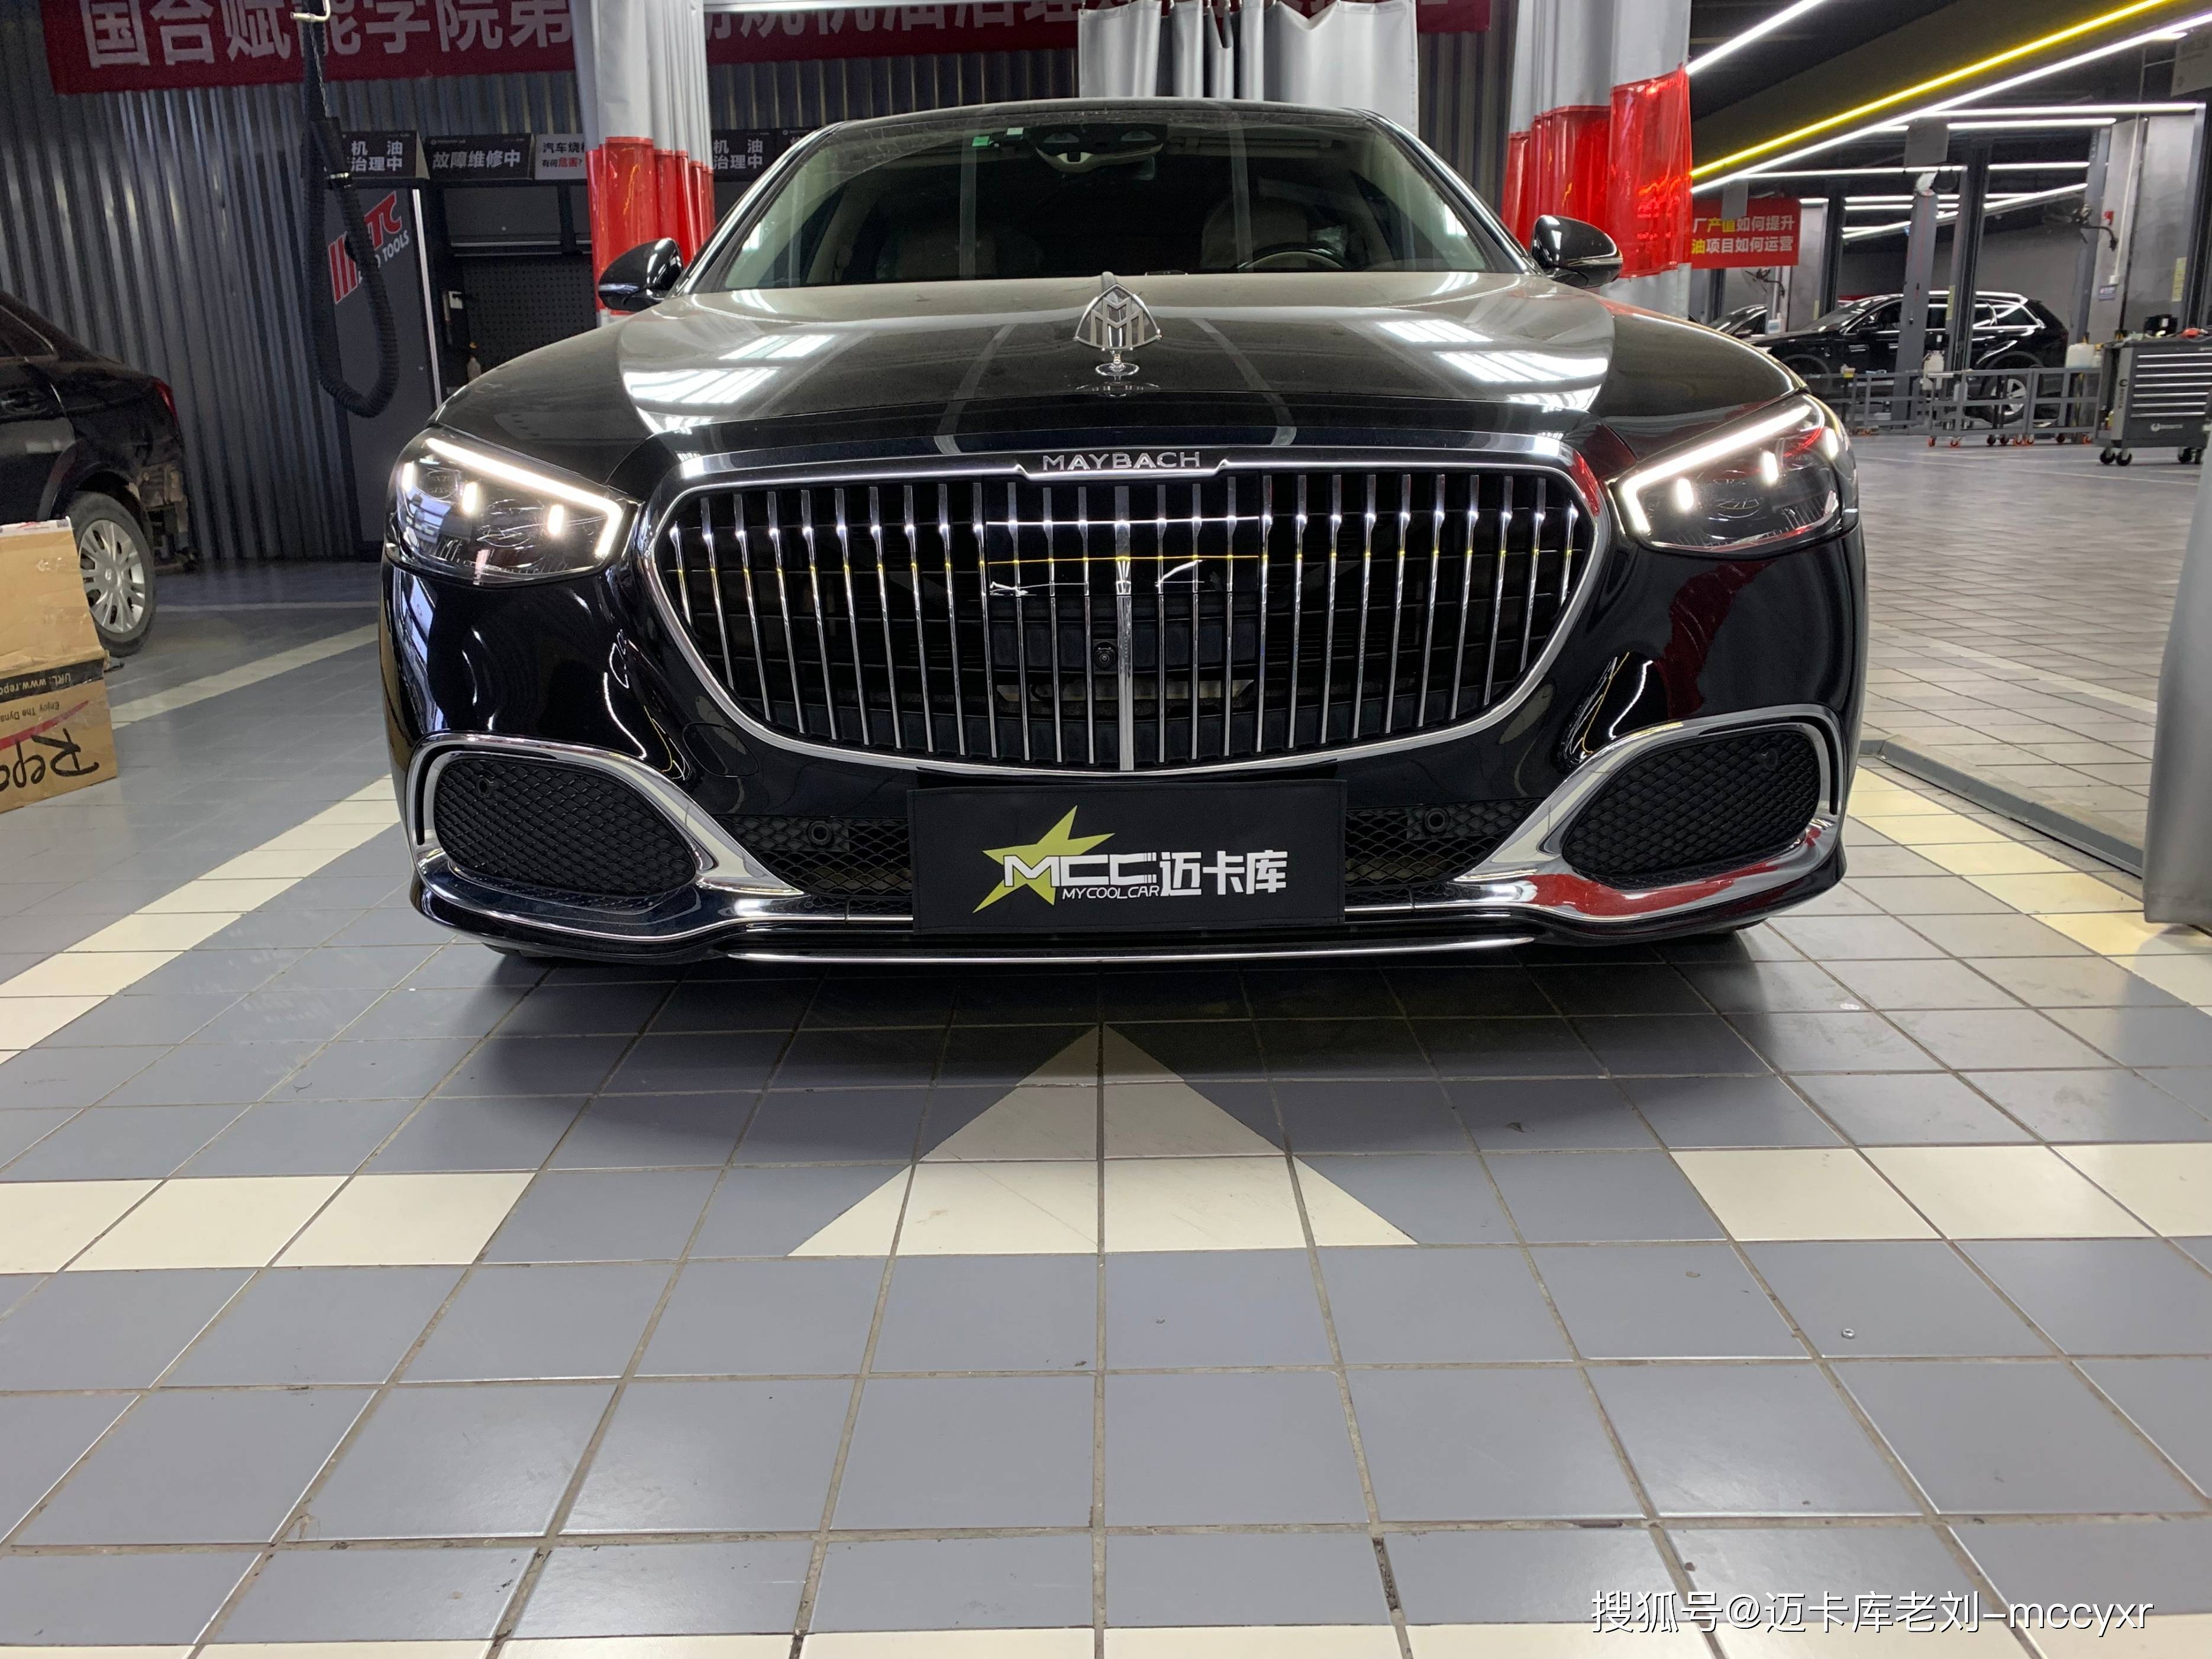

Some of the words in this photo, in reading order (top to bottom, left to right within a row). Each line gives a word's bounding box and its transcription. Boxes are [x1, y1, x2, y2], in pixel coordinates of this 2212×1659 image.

[351, 156, 403, 172] 治理中
[432, 149, 521, 169] 故障维修中
[713, 154, 763, 169] 治理中
[1693, 215, 1796, 234] 厂产值如何提升
[382, 229, 410, 262] TOOLS
[1691, 235, 1794, 254] 油项目如何运营
[1042, 451, 1201, 471] MAYBACH
[22, 707, 35, 716] The
[39, 701, 60, 713] Enjoy
